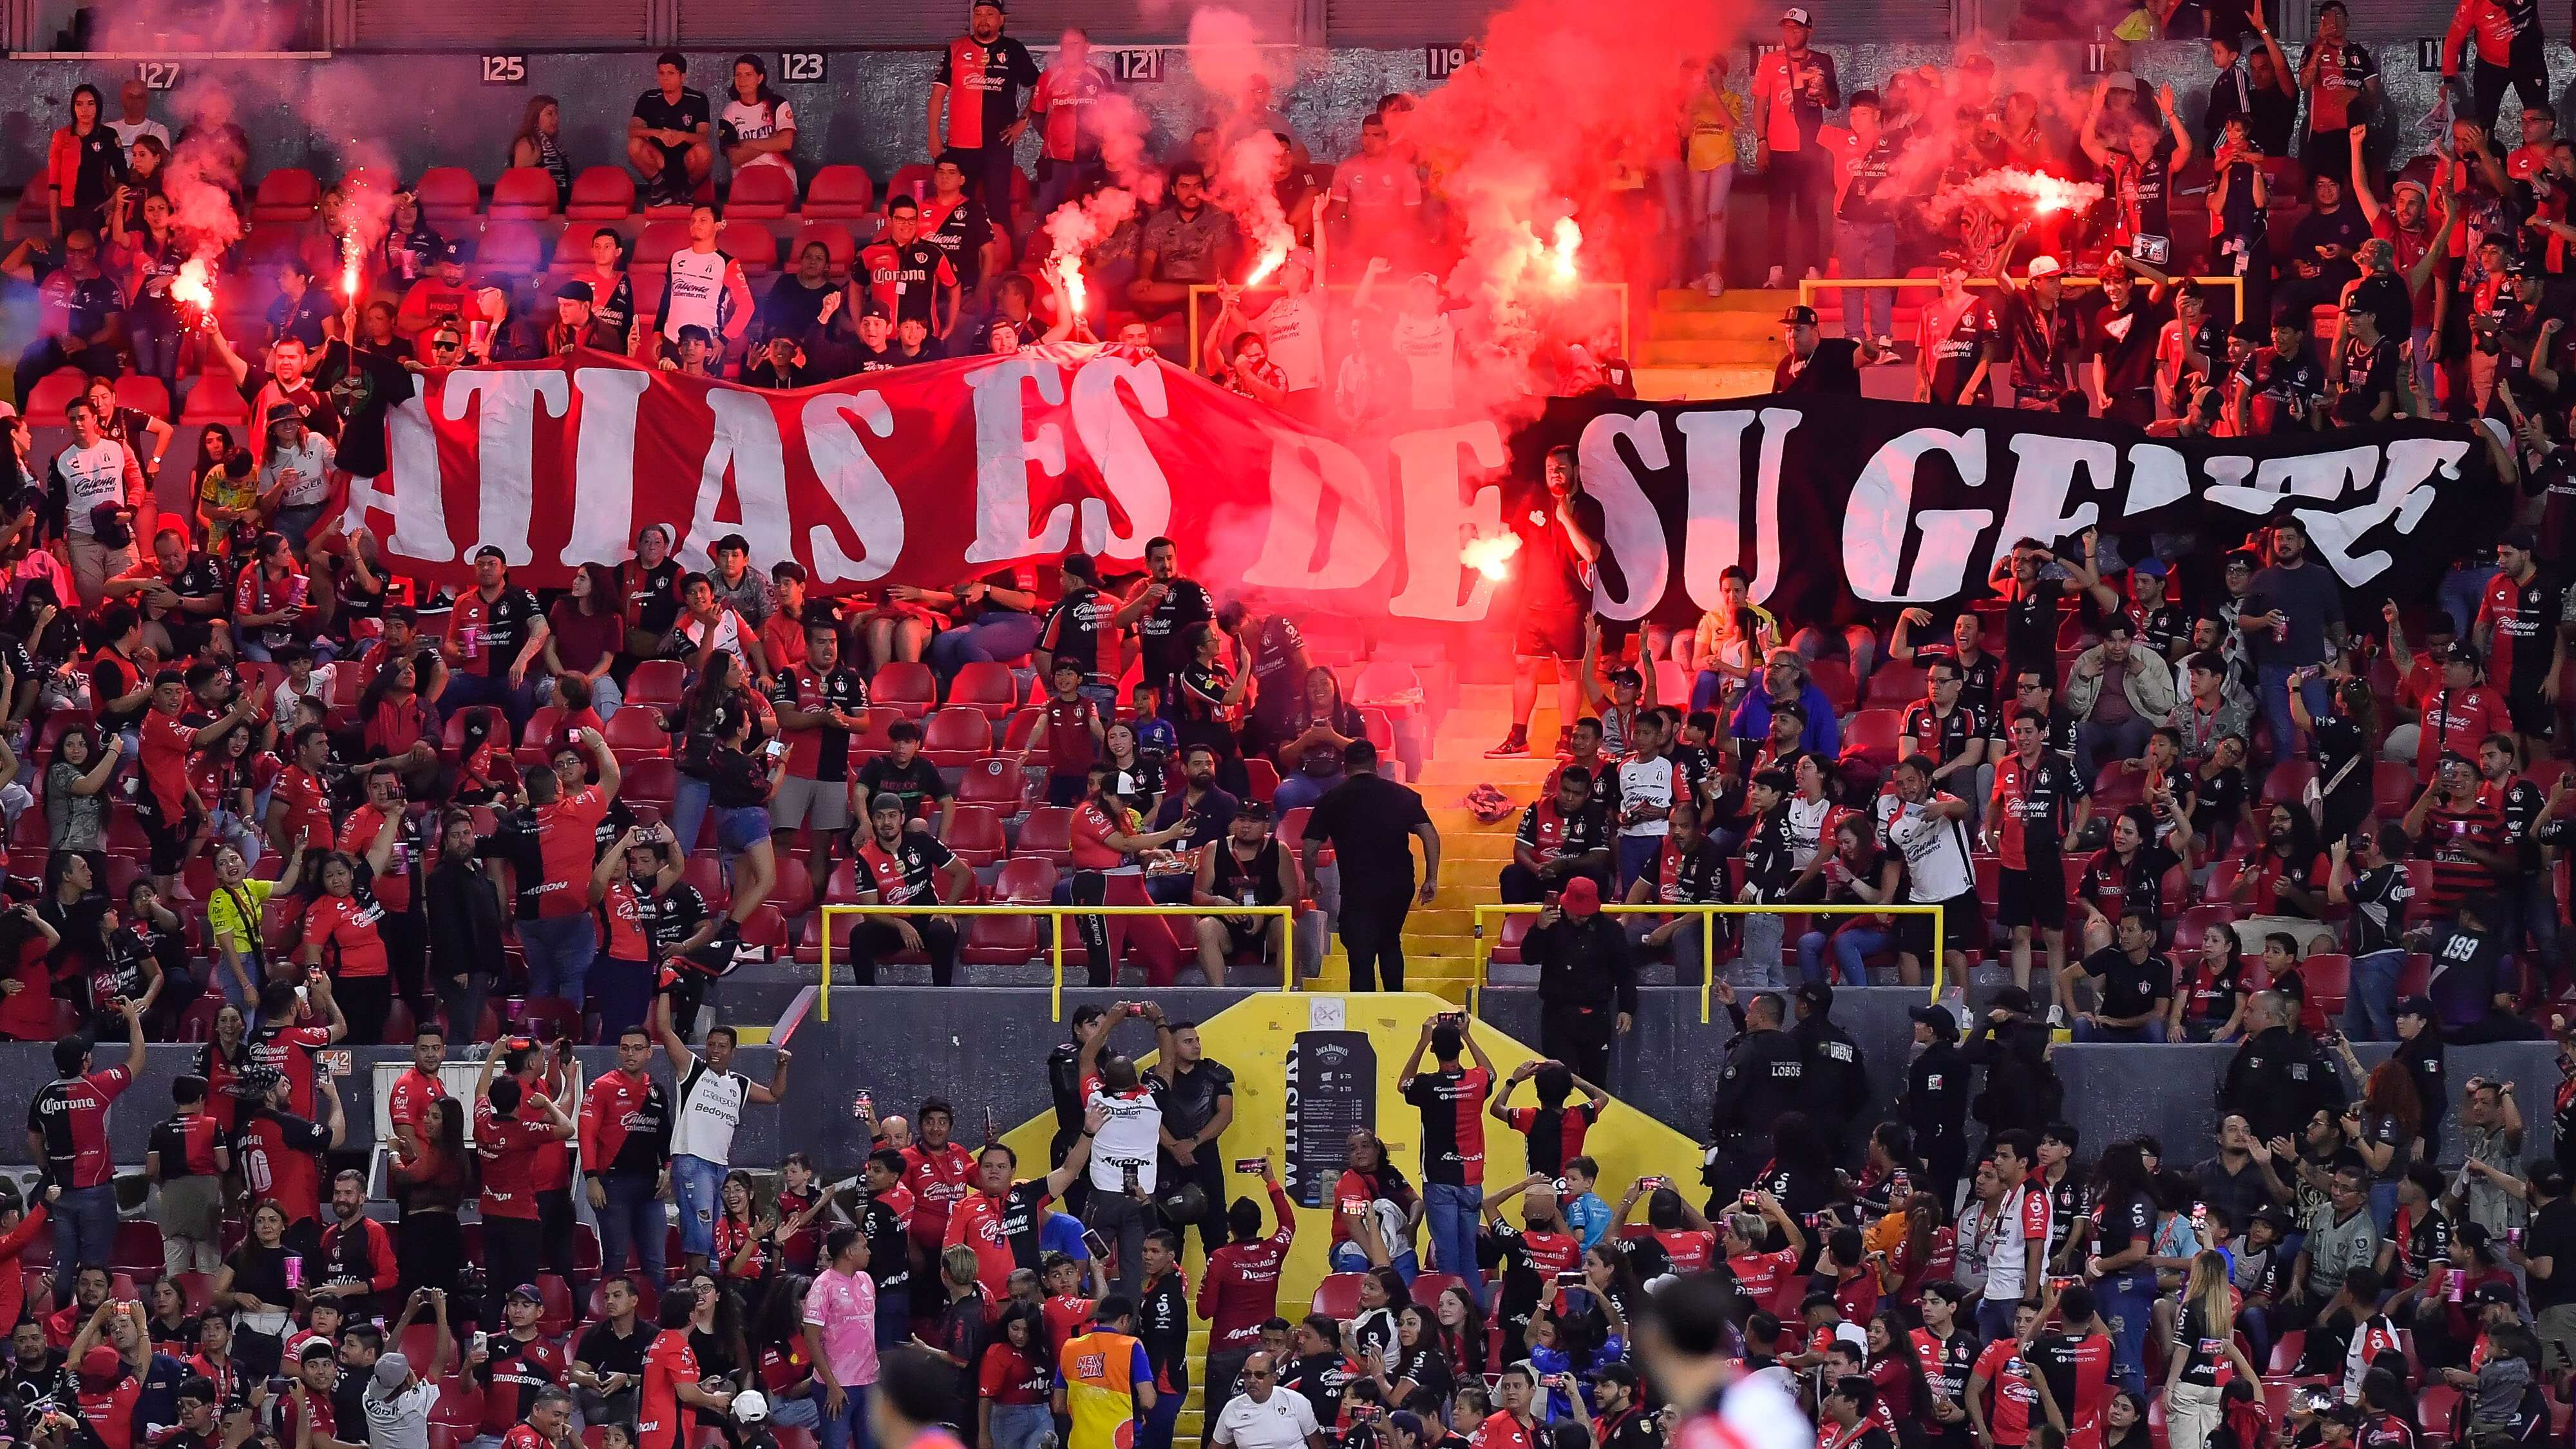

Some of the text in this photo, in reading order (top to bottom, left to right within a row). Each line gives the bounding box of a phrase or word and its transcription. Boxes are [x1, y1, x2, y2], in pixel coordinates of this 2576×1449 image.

[482, 57, 524, 80] 125
[783, 54, 823, 79] 123
[1122, 52, 1157, 79] 121
[1431, 48, 1466, 75] 119
[139, 62, 180, 88] 127
[963, 73, 1005, 84] Caliente
[2323, 74, 2362, 88] Caliente
[966, 84, 1002, 92] caliente.mx
[480, 222, 486, 232] 6
[563, 222, 570, 231] 7
[873, 267, 925, 285] Corona
[533, 278, 540, 289] 6
[672, 278, 710, 293] Caliente
[74, 476, 117, 494] Caliente
[79, 486, 116, 498] caliente.mx
[290, 478, 323, 496] JAVER
[342, 368, 904, 582] ATLAS
[964, 356, 1171, 564] ES
[1242, 420, 1505, 623] DE
[1578, 407, 1803, 621] SU
[1072, 602, 1114, 617] Caliente
[2497, 616, 2540, 630] Caliente
[1626, 792, 1664, 805] Caliente
[2007, 797, 2049, 811] Caliente
[1908, 835, 1941, 858] Caliente
[887, 880, 927, 902] Caliente
[351, 901, 381, 924] Caliente
[2442, 934, 2478, 961] 199
[250, 1042, 289, 1056] Caliente
[1316, 1046, 1328, 1057] JACK
[1830, 1045, 1853, 1063] UREPAZ
[1772, 1066, 1801, 1077] LOBOS
[41, 1097, 97, 1115] Corona
[620, 1111, 660, 1126] Caliente
[240, 1149, 272, 1193] 10
[923, 1182, 966, 1197] Caliente
[1260, 1258, 1276, 1267] Atlas
[1547, 1251, 1566, 1260] Atlas
[1686, 1251, 1700, 1260] Atlas
[1534, 1263, 1560, 1271] Dalton
[1747, 1286, 1772, 1294] Dalton
[1078, 1354, 1104, 1367] NEW
[1081, 1365, 1103, 1378] MIX
